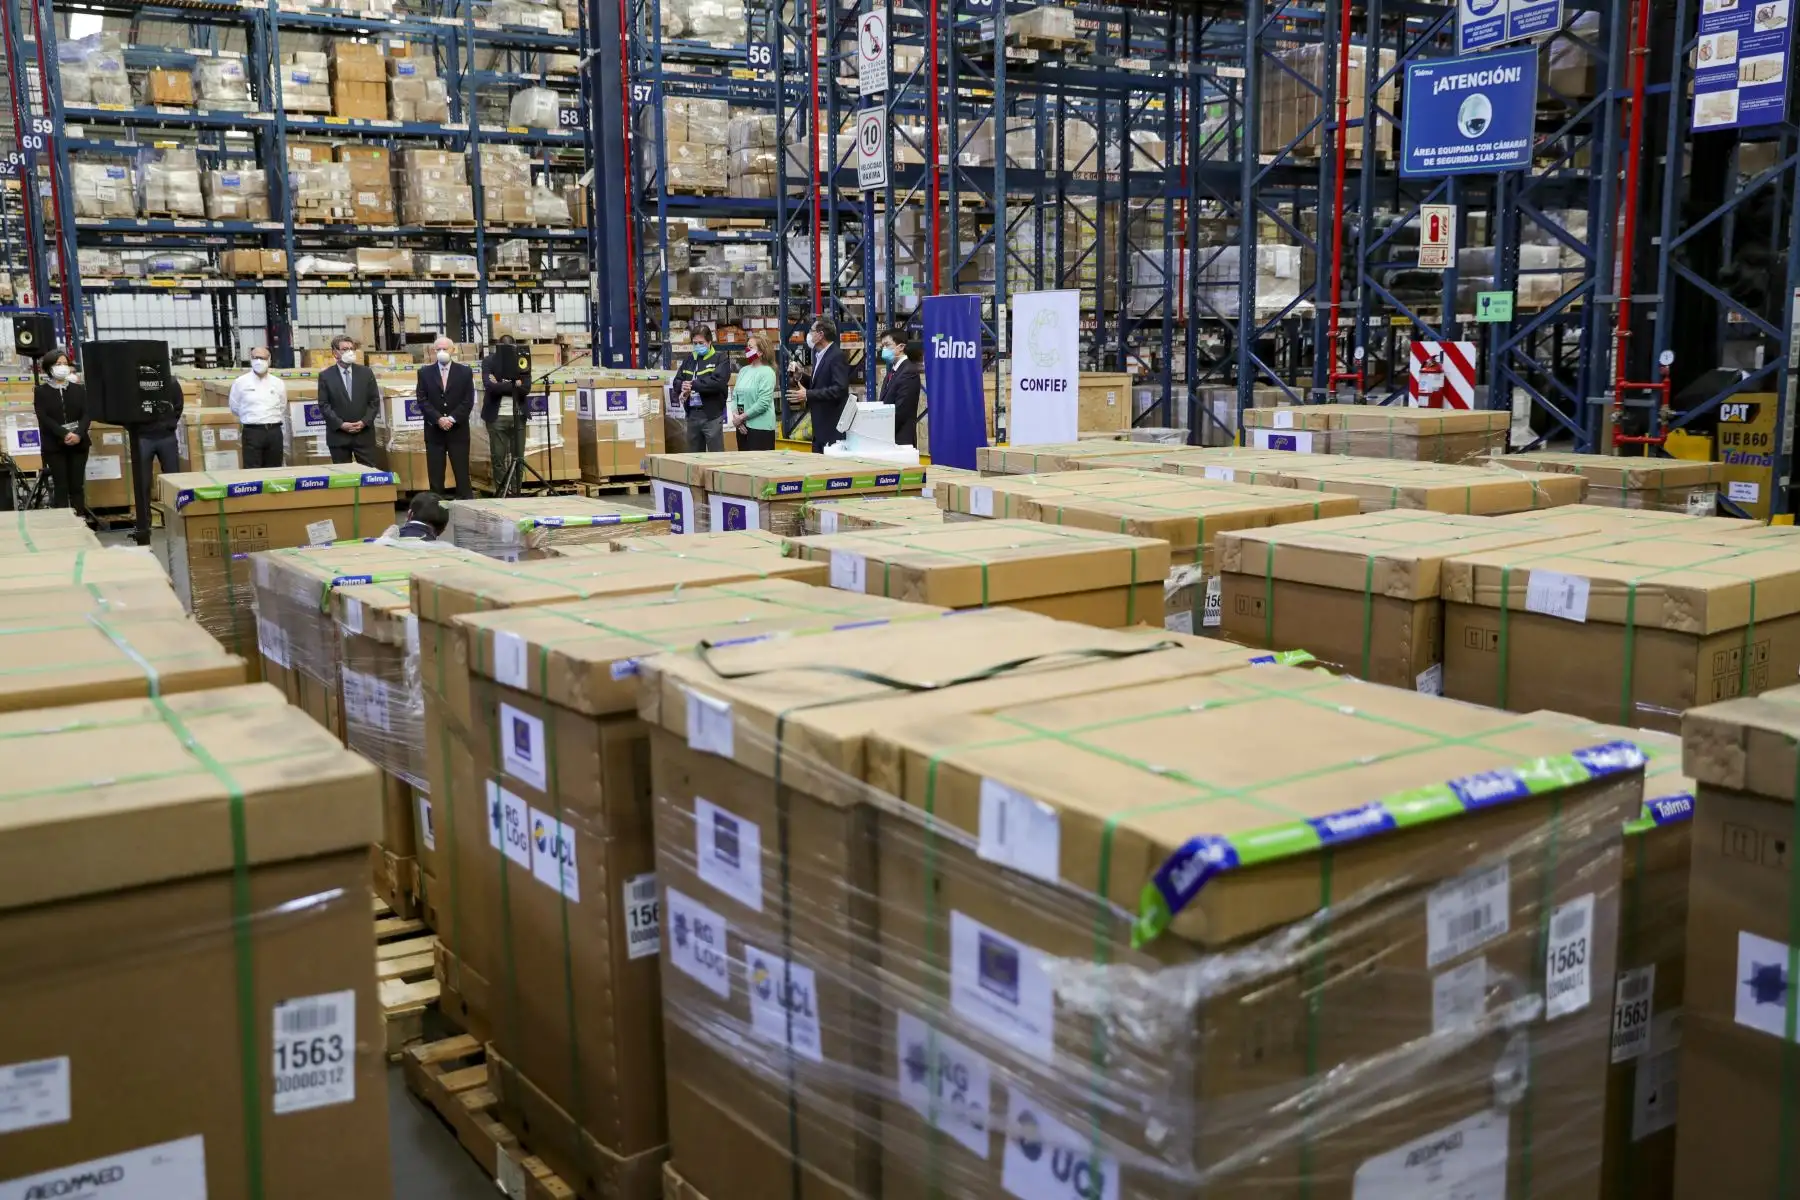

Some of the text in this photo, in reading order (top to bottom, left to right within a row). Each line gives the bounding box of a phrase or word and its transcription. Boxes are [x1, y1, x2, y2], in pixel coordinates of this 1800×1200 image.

[749, 45, 771, 65] 56
[1433, 65, 1521, 95] ¡ATENCIÓN!
[634, 85, 651, 101] 57
[560, 109, 579, 125] 58
[33, 119, 53, 134] 59
[864, 124, 877, 147] 10
[22, 135, 42, 149] 60
[1413, 138, 1528, 157] ÁREA EQUIPADA CON CÁMARAS
[9, 152, 26, 165] 61
[861, 161, 883, 173] VELOCIDAD
[1423, 158, 1435, 166] DE
[1436, 154, 1479, 165] SEGURIDAD
[1480, 153, 1495, 162] LAS
[931, 335, 976, 359] Talma
[1020, 378, 1068, 392] CONFIEP
[1720, 404, 1749, 422] CAT
[1723, 431, 1768, 447] UE 860
[1721, 448, 1773, 467] Talma
[301, 479, 324, 489] Talma
[366, 475, 389, 483] Talma
[781, 483, 799, 493] Talma
[830, 479, 849, 489] Talma
[879, 476, 896, 485] Talma
[233, 484, 258, 495] Talma
[338, 577, 367, 587] Talma
[505, 804, 519, 828] RG
[1657, 799, 1691, 818] Talma
[506, 826, 527, 852] LOG
[550, 837, 574, 867] UCL
[694, 917, 714, 945] RG
[694, 944, 725, 978] LOG
[1549, 937, 1586, 977] 1563
[1616, 999, 1649, 1030] 1563
[274, 1034, 344, 1071] 1563
[275, 1066, 344, 1094] 00000312
